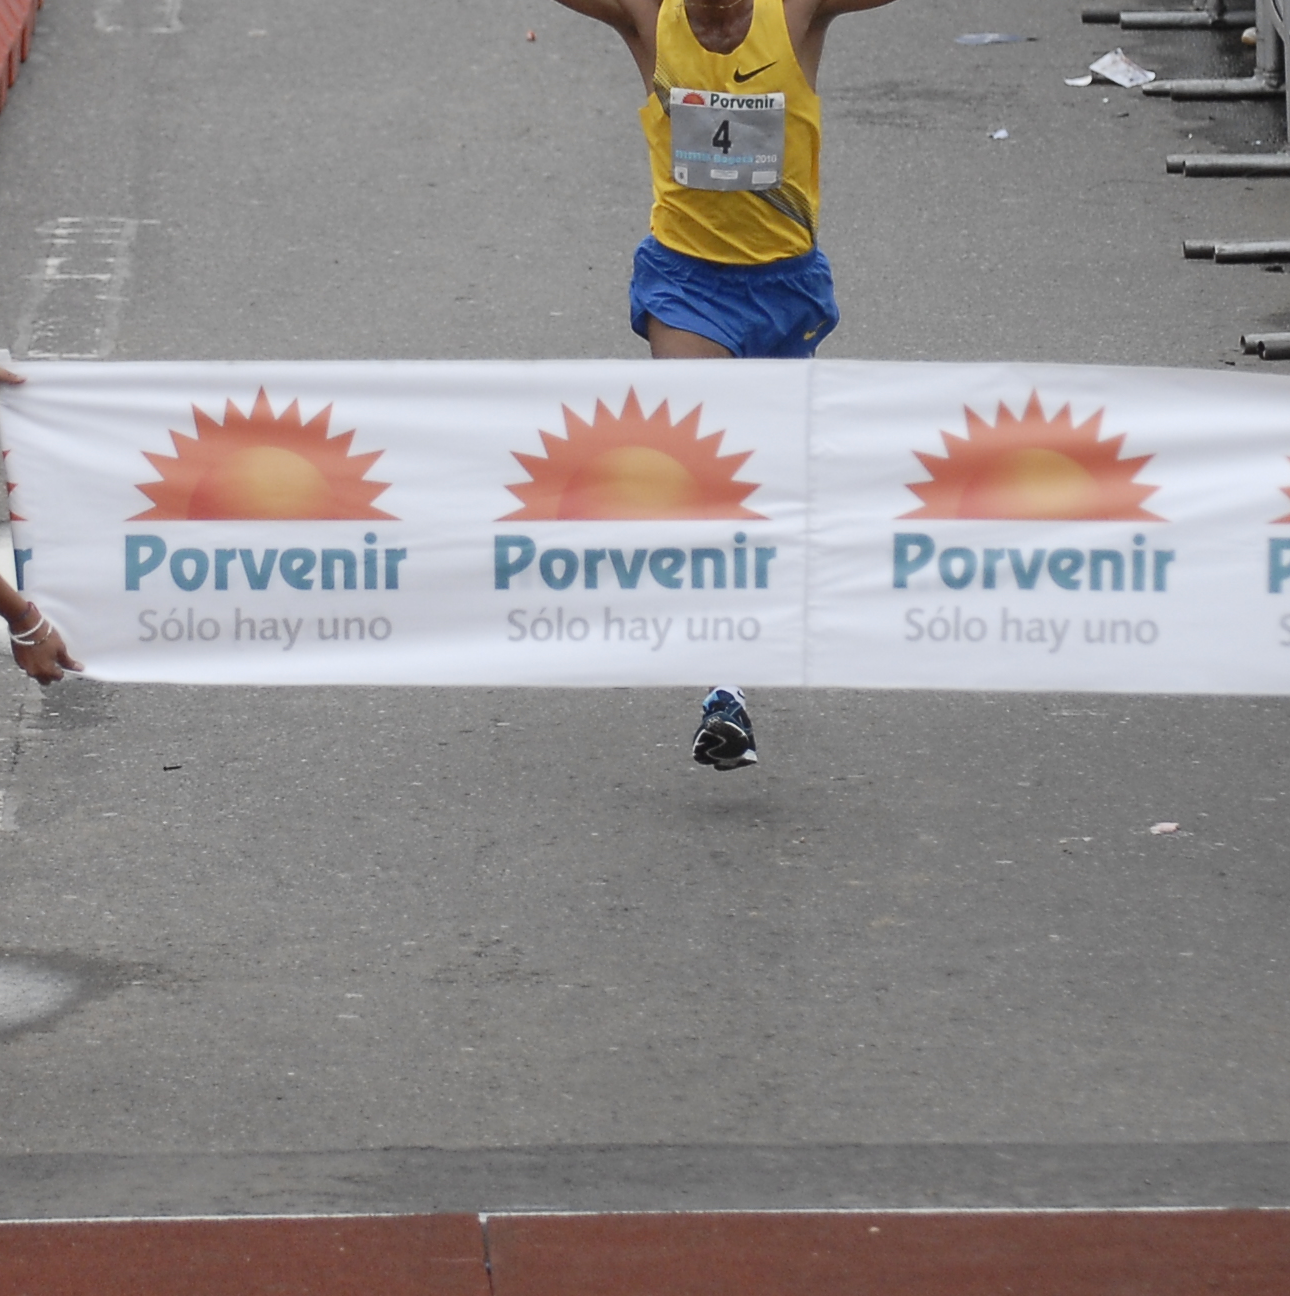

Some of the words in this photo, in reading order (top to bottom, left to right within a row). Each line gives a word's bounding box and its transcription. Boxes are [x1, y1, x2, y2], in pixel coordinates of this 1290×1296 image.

[709, 93, 776, 109] Porvenir
[712, 119, 732, 154] 4
[755, 154, 778, 164] 2010
[124, 531, 407, 593] Porvenir
[493, 532, 777, 591] Porvenir
[892, 532, 1175, 592] Porvenir
[137, 607, 222, 644] Sólo
[233, 607, 306, 655] hay
[317, 616, 393, 645] uno
[505, 605, 594, 645] Sólo
[598, 601, 679, 652] hay
[686, 607, 762, 643] uno
[904, 606, 988, 644] Sólo
[999, 607, 1070, 655] hay
[1083, 618, 1160, 646] uno
